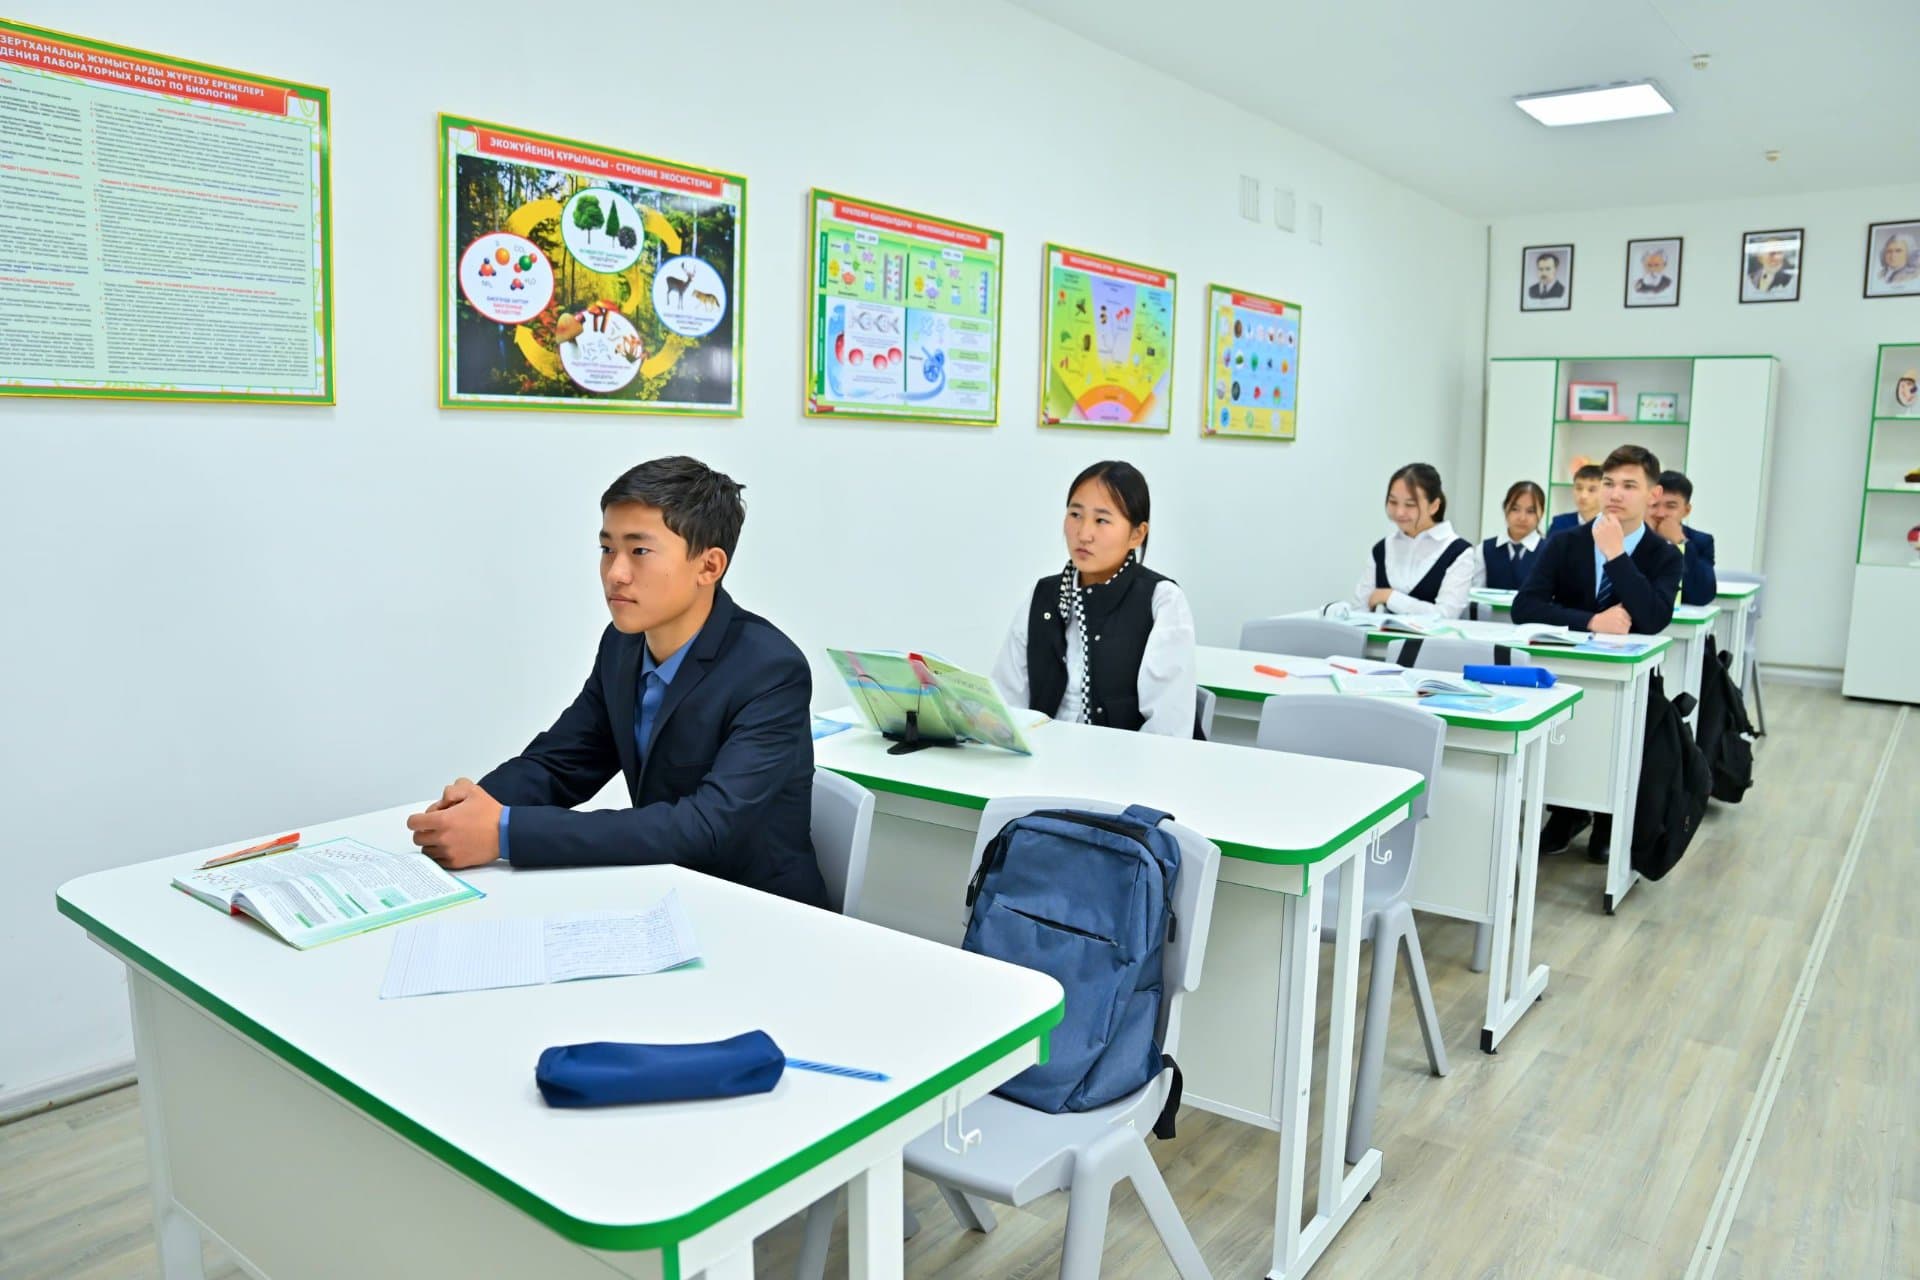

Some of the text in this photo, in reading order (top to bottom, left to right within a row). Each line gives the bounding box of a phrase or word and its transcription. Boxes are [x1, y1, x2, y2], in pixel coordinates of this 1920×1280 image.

[43, 56, 131, 81] ЛАБОРАТОРНЫХ
[134, 74, 167, 88] РАБОТ
[169, 81, 184, 91] ПО
[186, 84, 238, 101] БИОЛОГИИ
[211, 79, 265, 97] ЕРЕЖЕЛЕРІ
[615, 162, 658, 178] СТРОЕНИЕ
[660, 171, 713, 189] ЭКОСИСТЕМЫ
